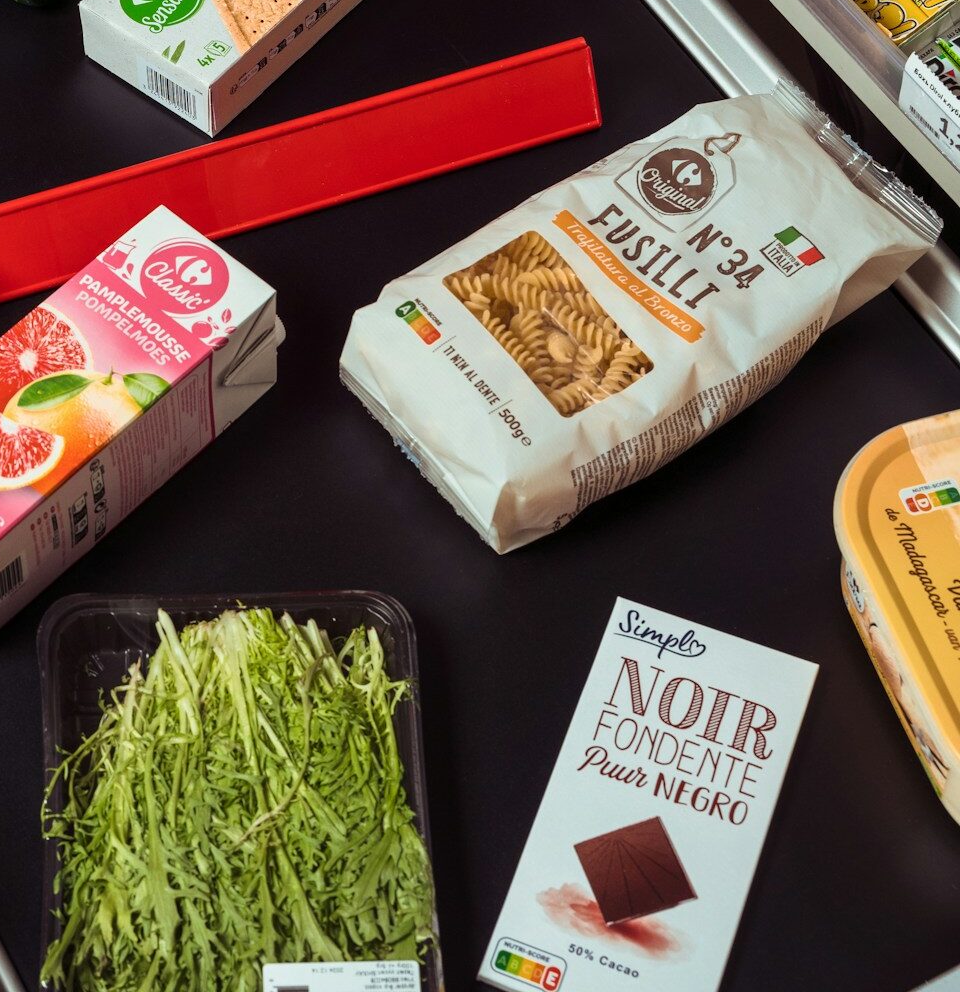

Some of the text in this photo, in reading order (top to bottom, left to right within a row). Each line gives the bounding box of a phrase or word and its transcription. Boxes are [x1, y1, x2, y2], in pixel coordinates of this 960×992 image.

[639, 167, 705, 211] Original
[564, 221, 693, 333] Trafilatura al Bronzo
[587, 203, 721, 310] FUSILLI
[767, 247, 795, 275] ITALIA
[75, 291, 171, 366] POMPELMOES
[79, 274, 191, 364] PAMPLEMOUSSE
[449, 353, 469, 373] MIN
[464, 369, 478, 383] AL
[473, 378, 501, 406] DENTE
[497, 407, 525, 441] 500g
[912, 480, 952, 493] NUTRI-SCORE
[885, 508, 901, 521] de
[894, 522, 949, 619] Madagascar
[603, 656, 778, 761] NOIR
[576, 745, 749, 826] Puur NEGRO
[593, 709, 763, 799] FONDENTE
[503, 941, 551, 963] NUTRI-SCORE
[568, 943, 640, 979] 50% Cacao
